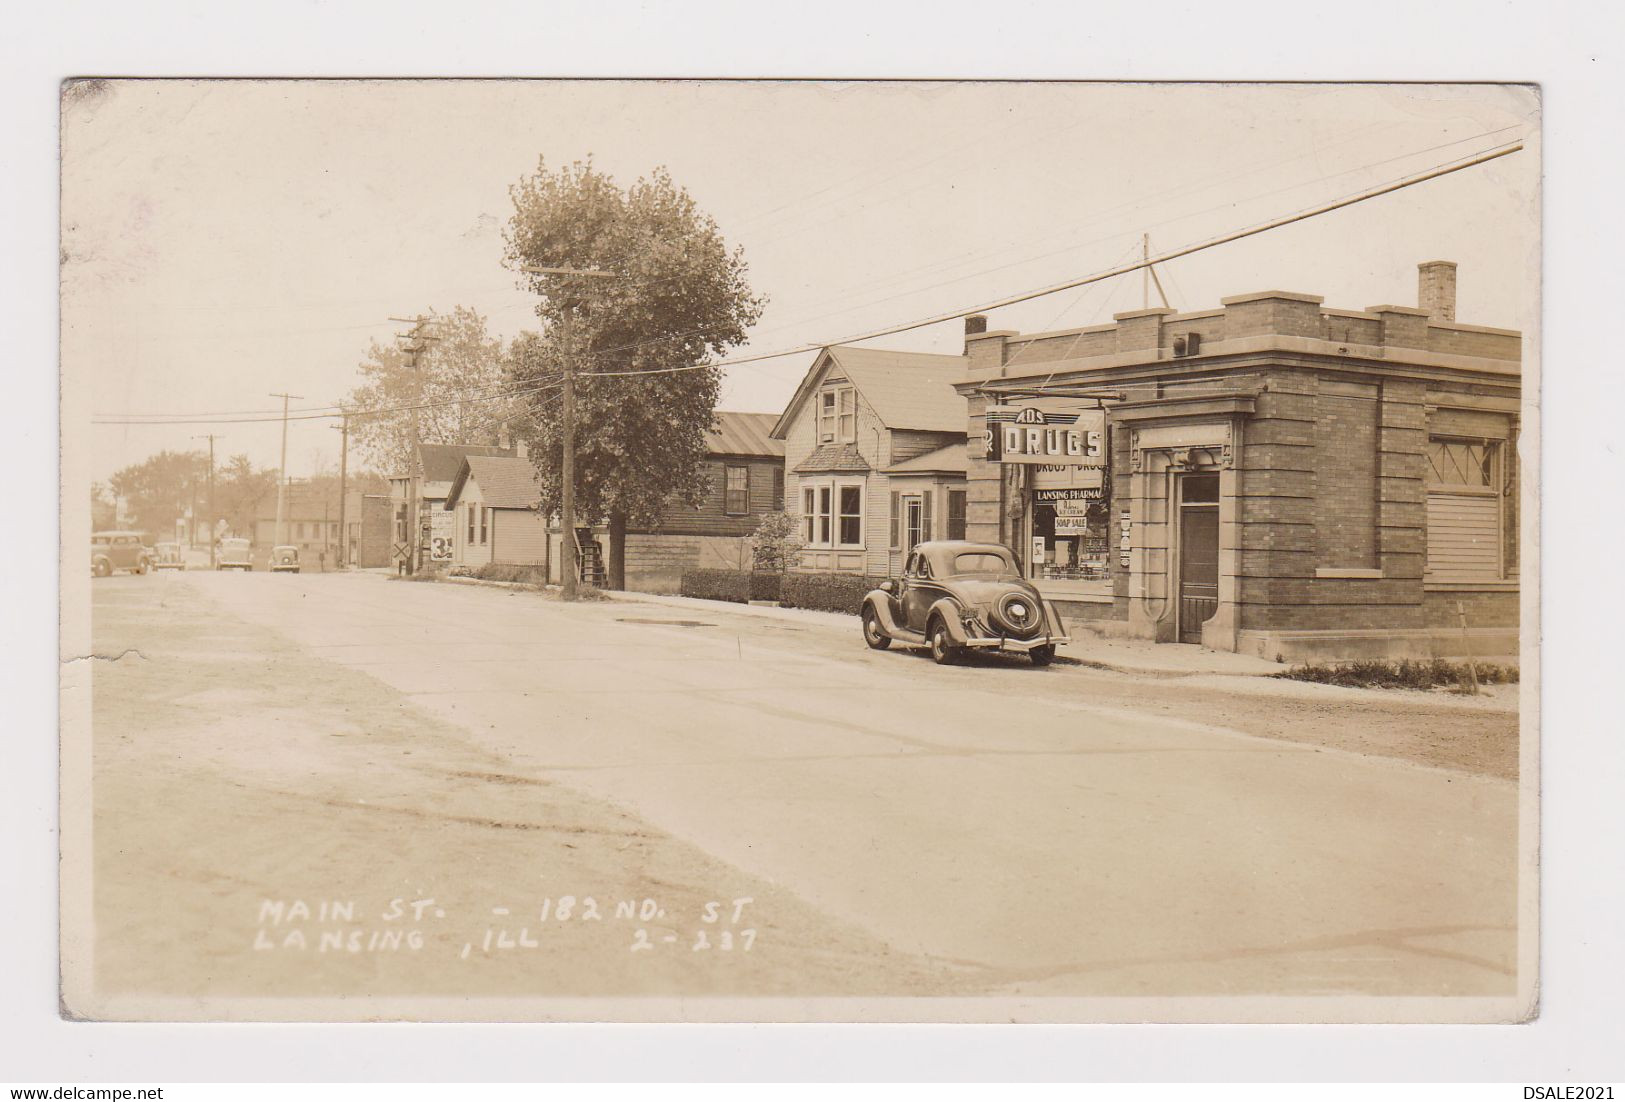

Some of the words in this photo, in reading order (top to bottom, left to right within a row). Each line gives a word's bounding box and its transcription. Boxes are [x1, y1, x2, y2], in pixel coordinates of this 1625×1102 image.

[1006, 428, 1102, 457] DRUGS
[1037, 489, 1069, 500] LANSING
[1056, 518, 1070, 528] SOAP
[1072, 518, 1085, 528] SALE
